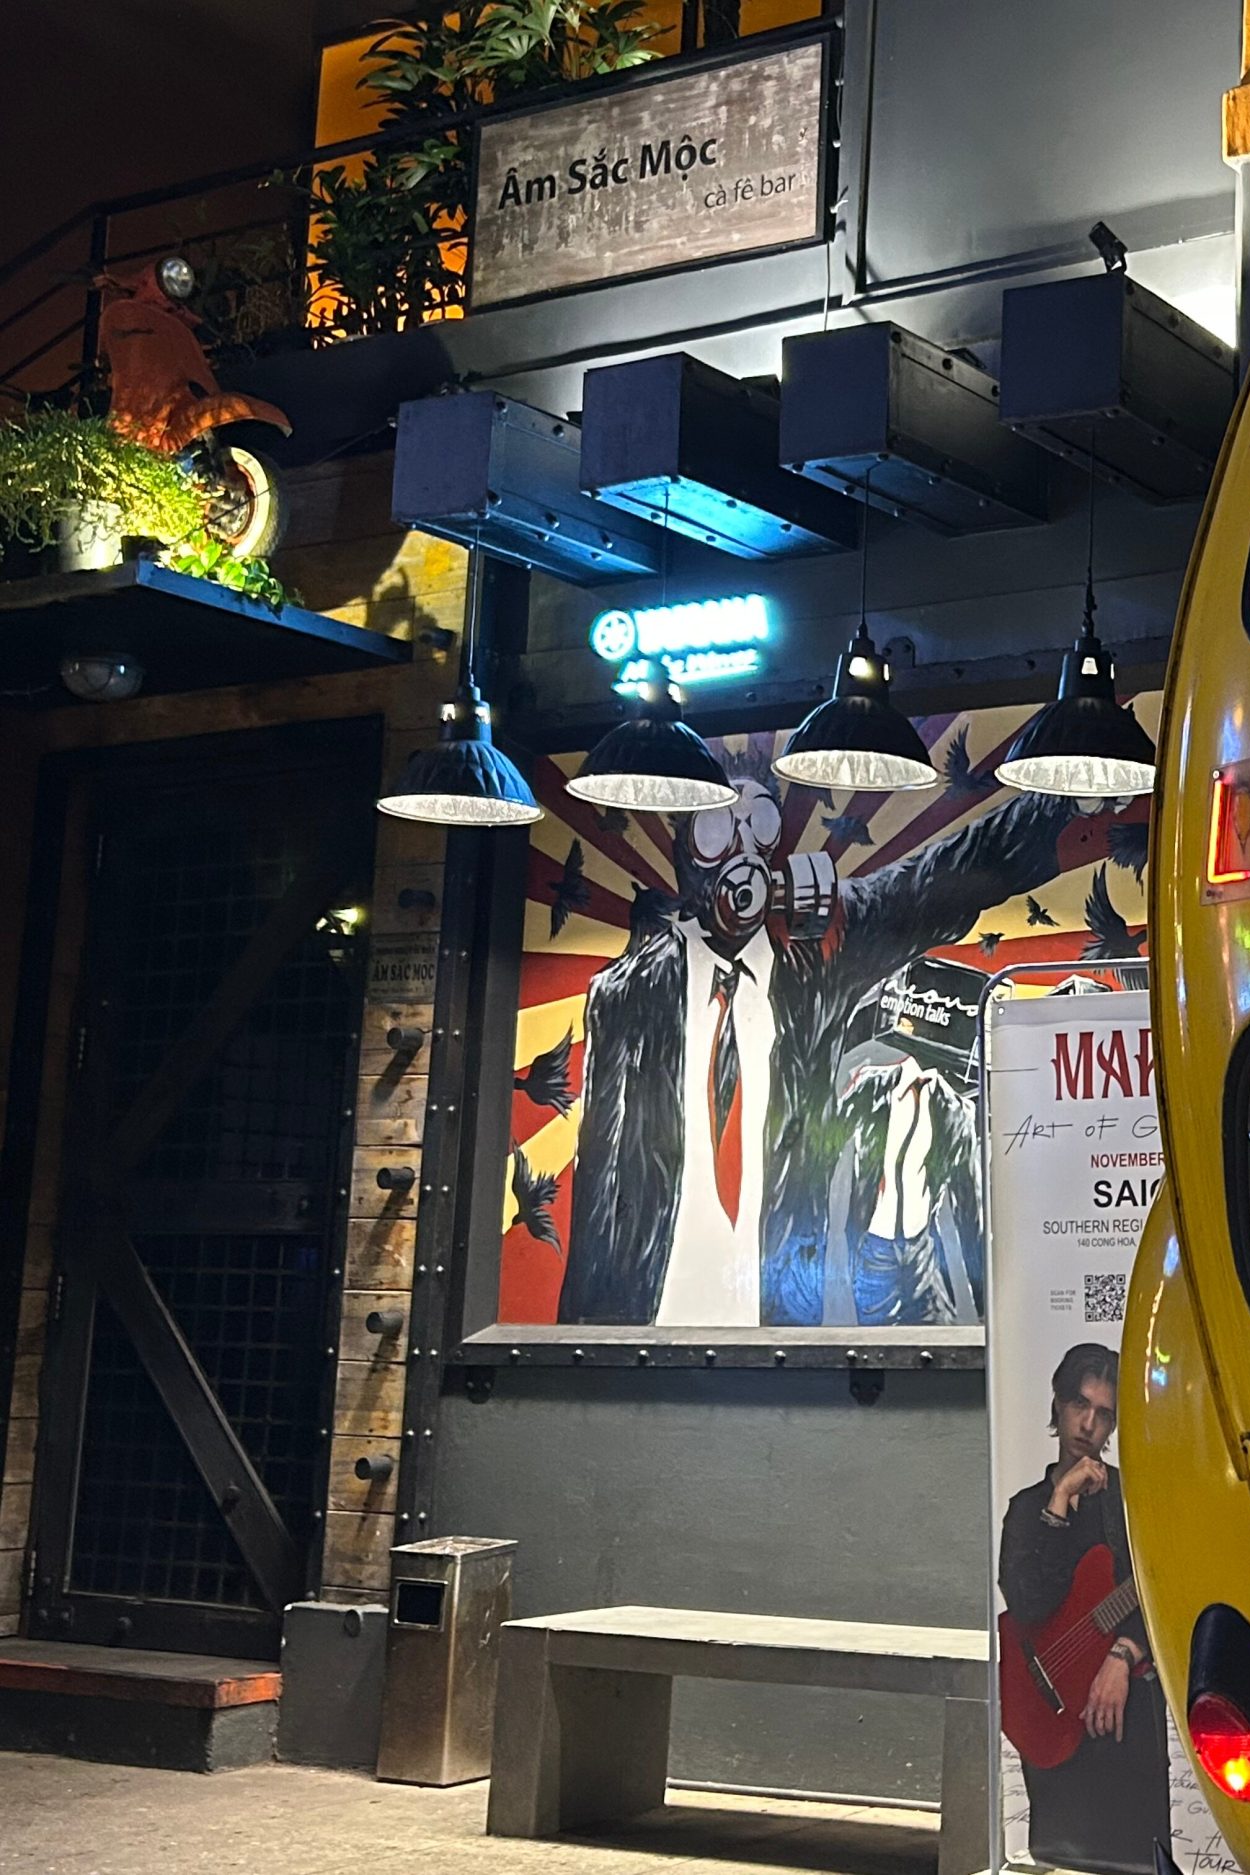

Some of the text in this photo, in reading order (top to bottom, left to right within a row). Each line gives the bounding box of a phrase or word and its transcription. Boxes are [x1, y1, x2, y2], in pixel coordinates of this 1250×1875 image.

[499, 135, 718, 210] Âm Sắc Mộc
[704, 172, 796, 209] cà fê bar
[925, 1004, 951, 1027] talks
[1043, 1220, 1109, 1234] SOUTHERN
[1077, 1238, 1090, 1248] 140
[1091, 1237, 1116, 1248] CONG
